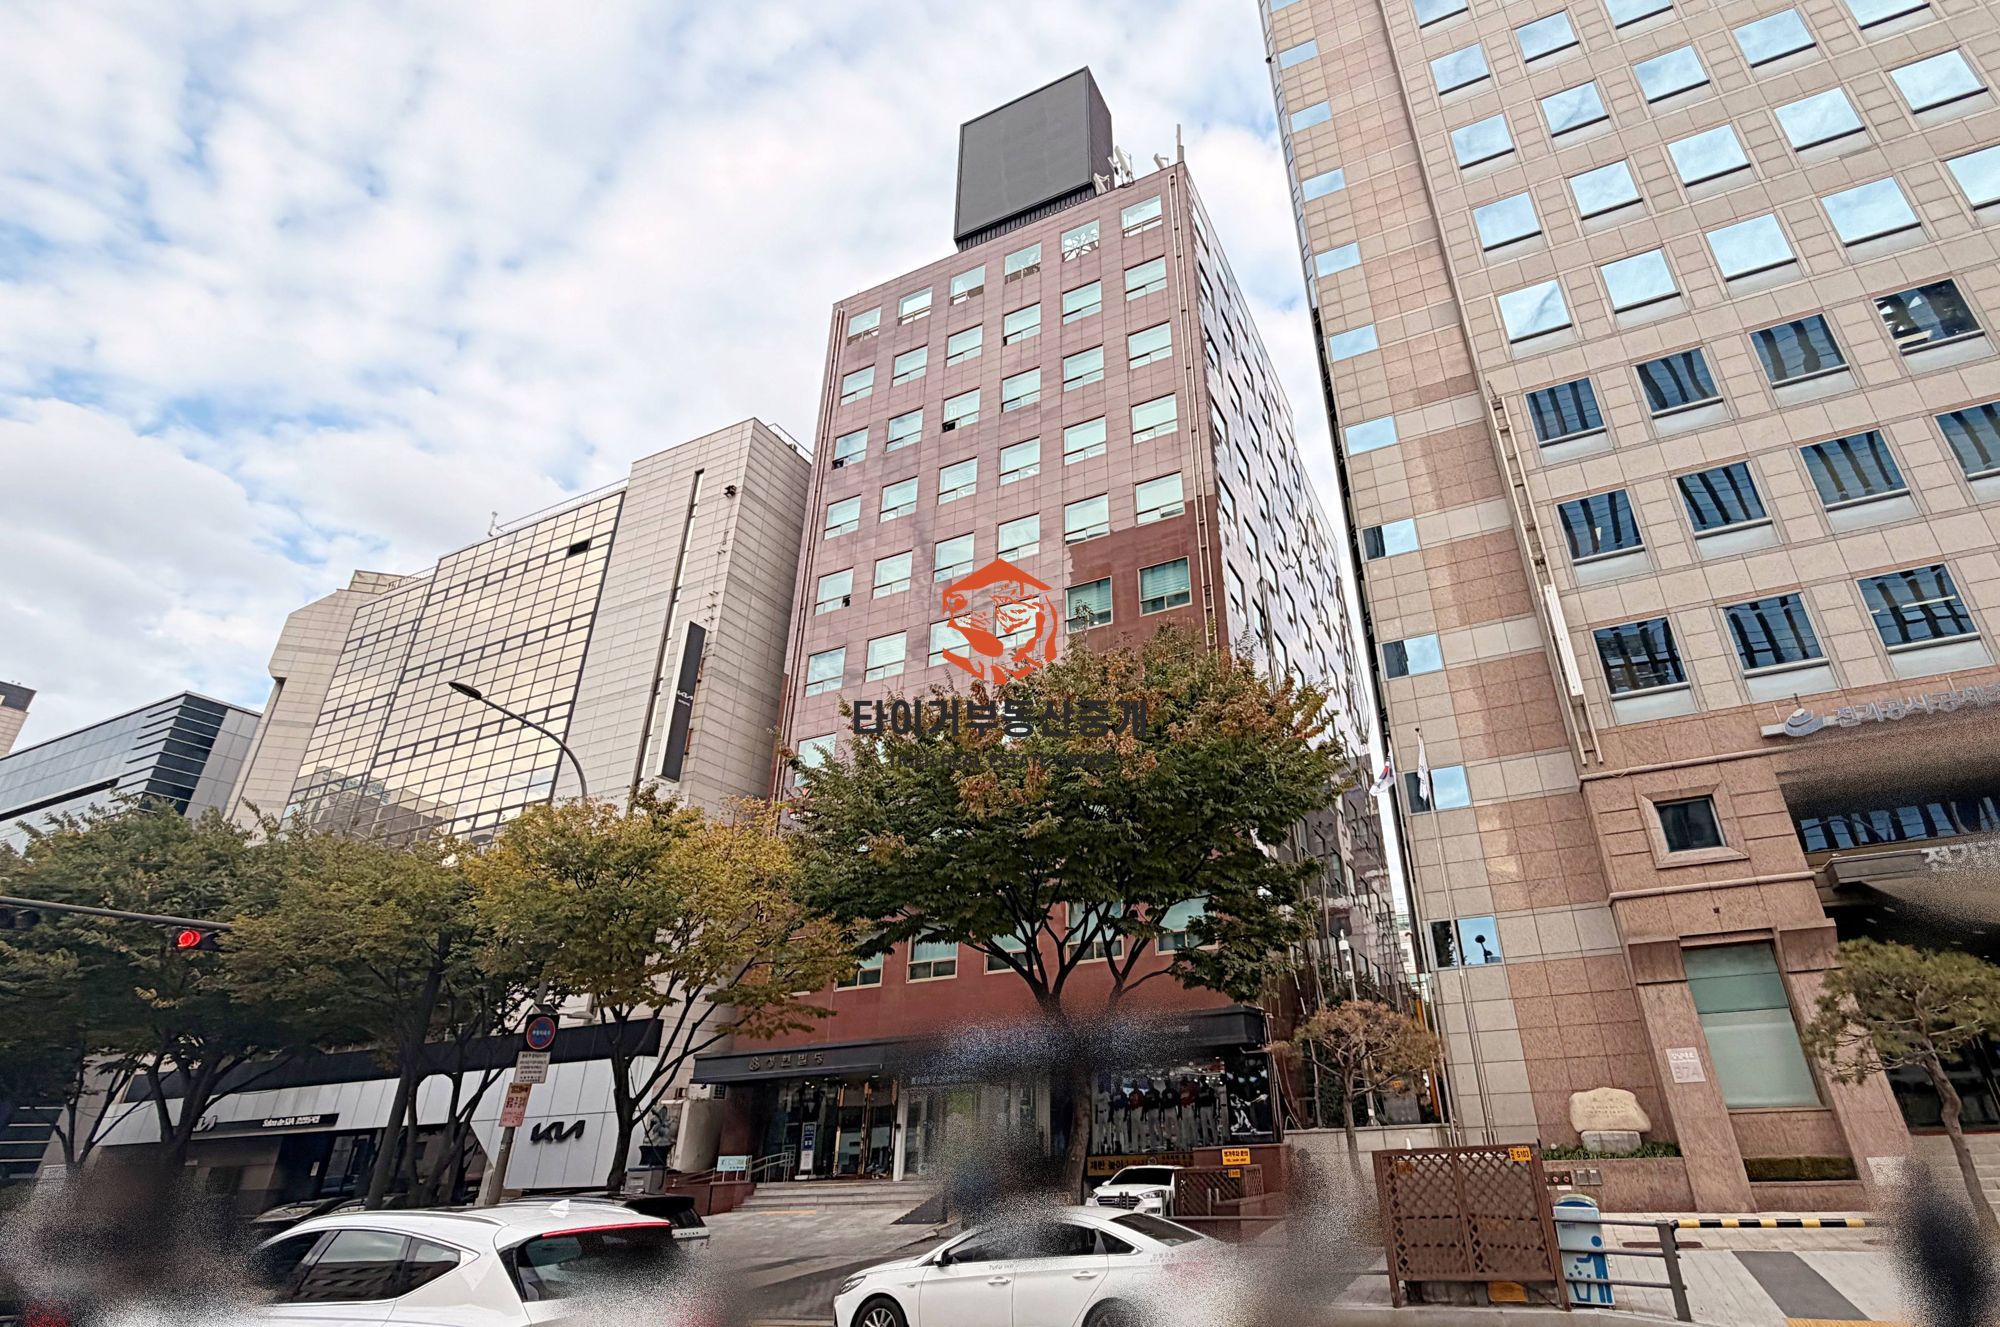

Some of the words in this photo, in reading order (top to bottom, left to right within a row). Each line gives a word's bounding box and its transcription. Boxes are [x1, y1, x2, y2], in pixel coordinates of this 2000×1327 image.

[677, 690, 693, 700] KIA
[1833, 684, 2000, 727] 전기공사공제
[531, 1120, 586, 1142] KIA
